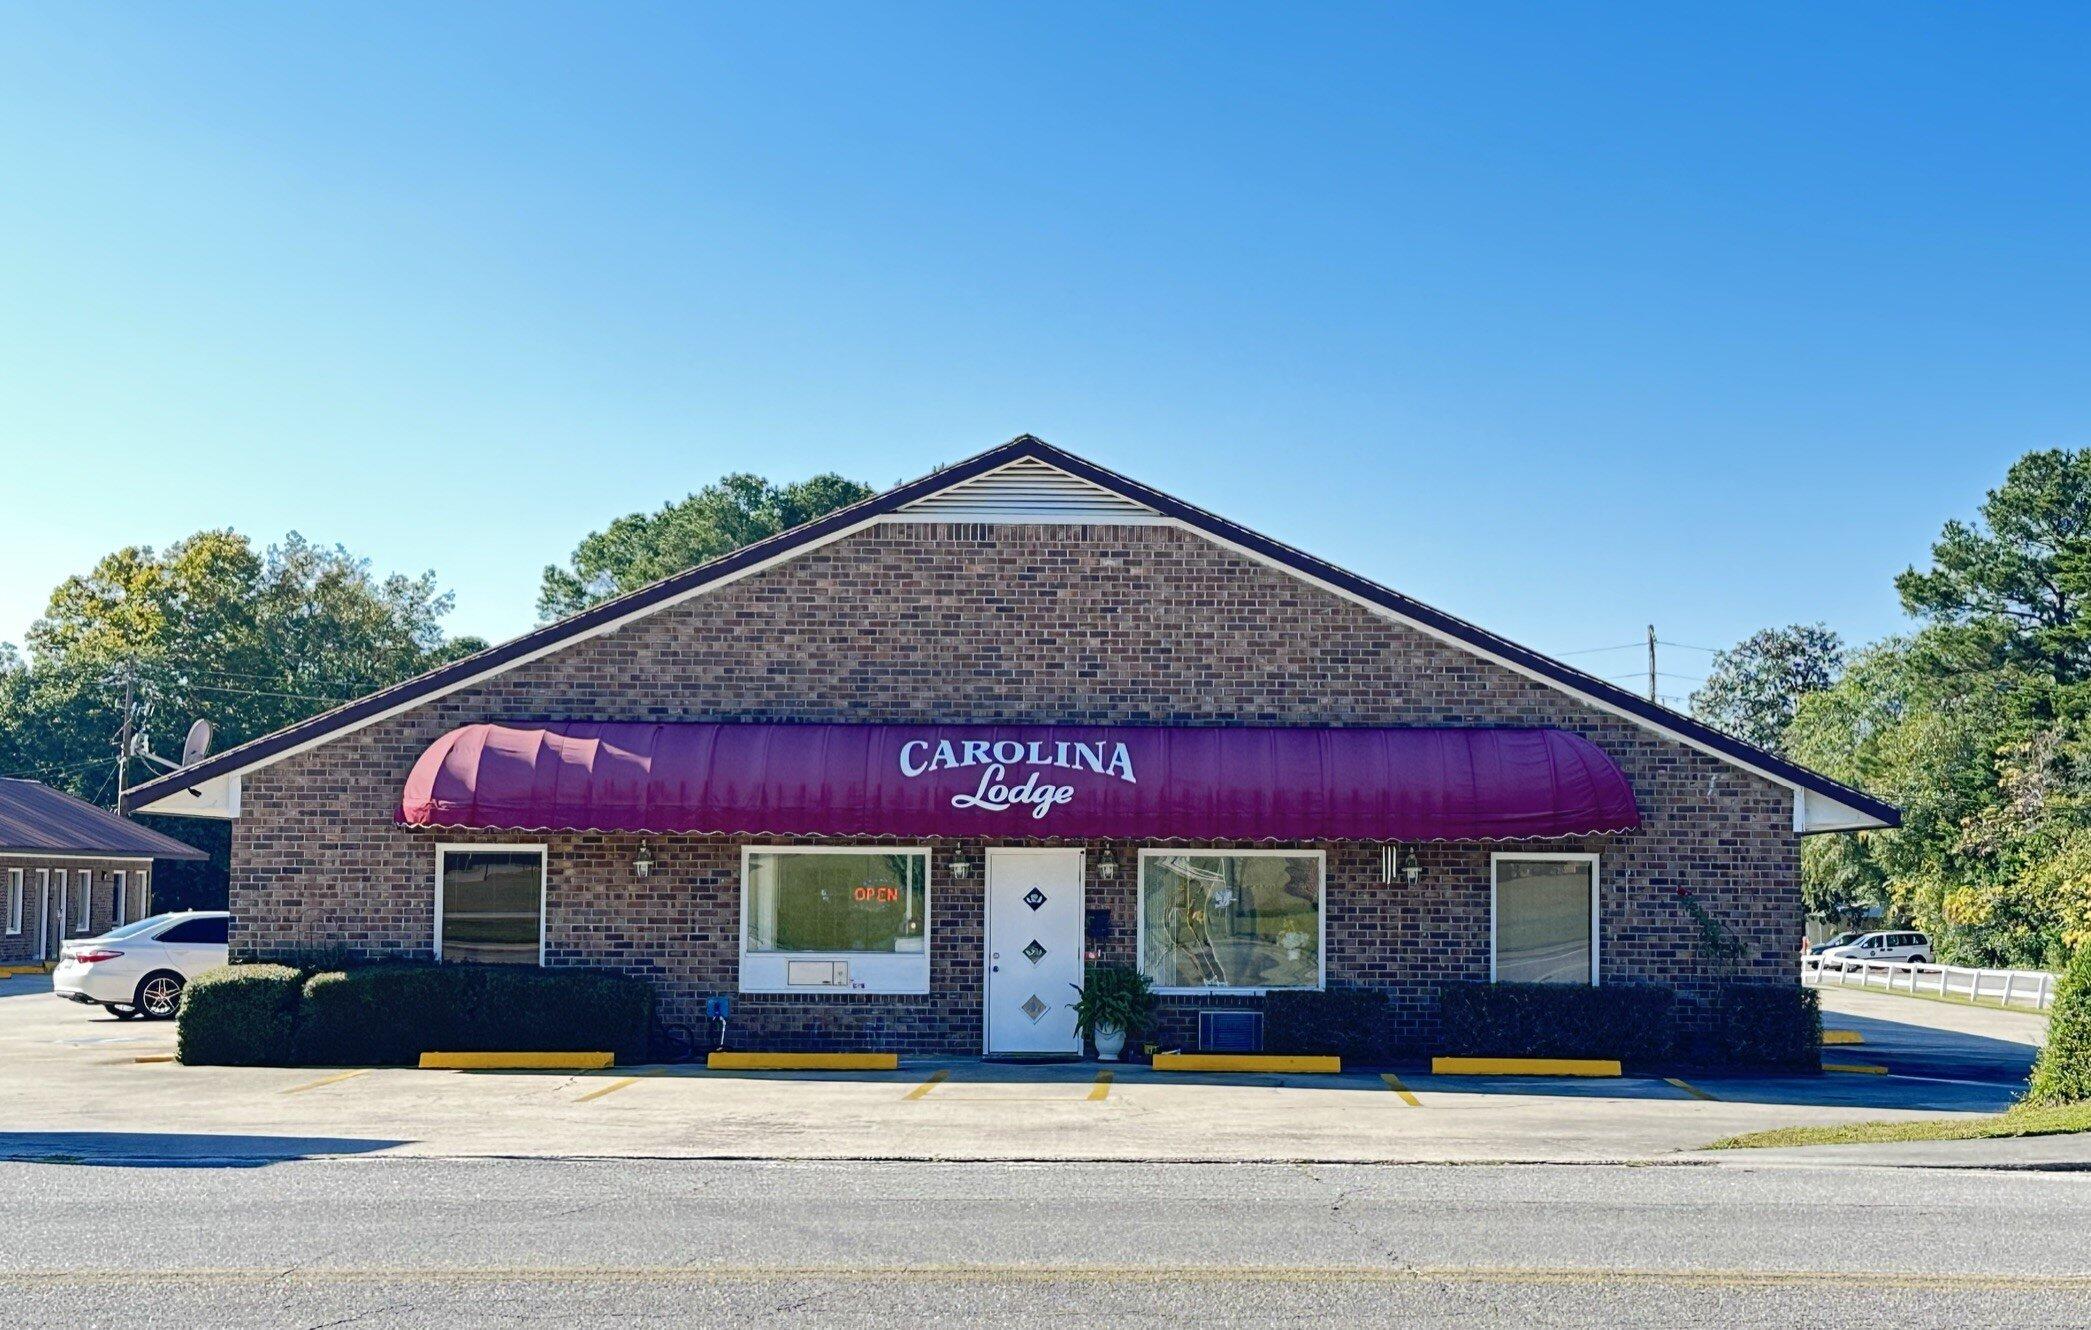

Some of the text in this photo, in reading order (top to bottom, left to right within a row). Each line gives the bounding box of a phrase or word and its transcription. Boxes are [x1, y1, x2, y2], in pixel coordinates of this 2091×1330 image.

[899, 739, 1137, 784] CAROLINA
[951, 763, 1075, 820] Lodge
[854, 886, 898, 902] OPEN
